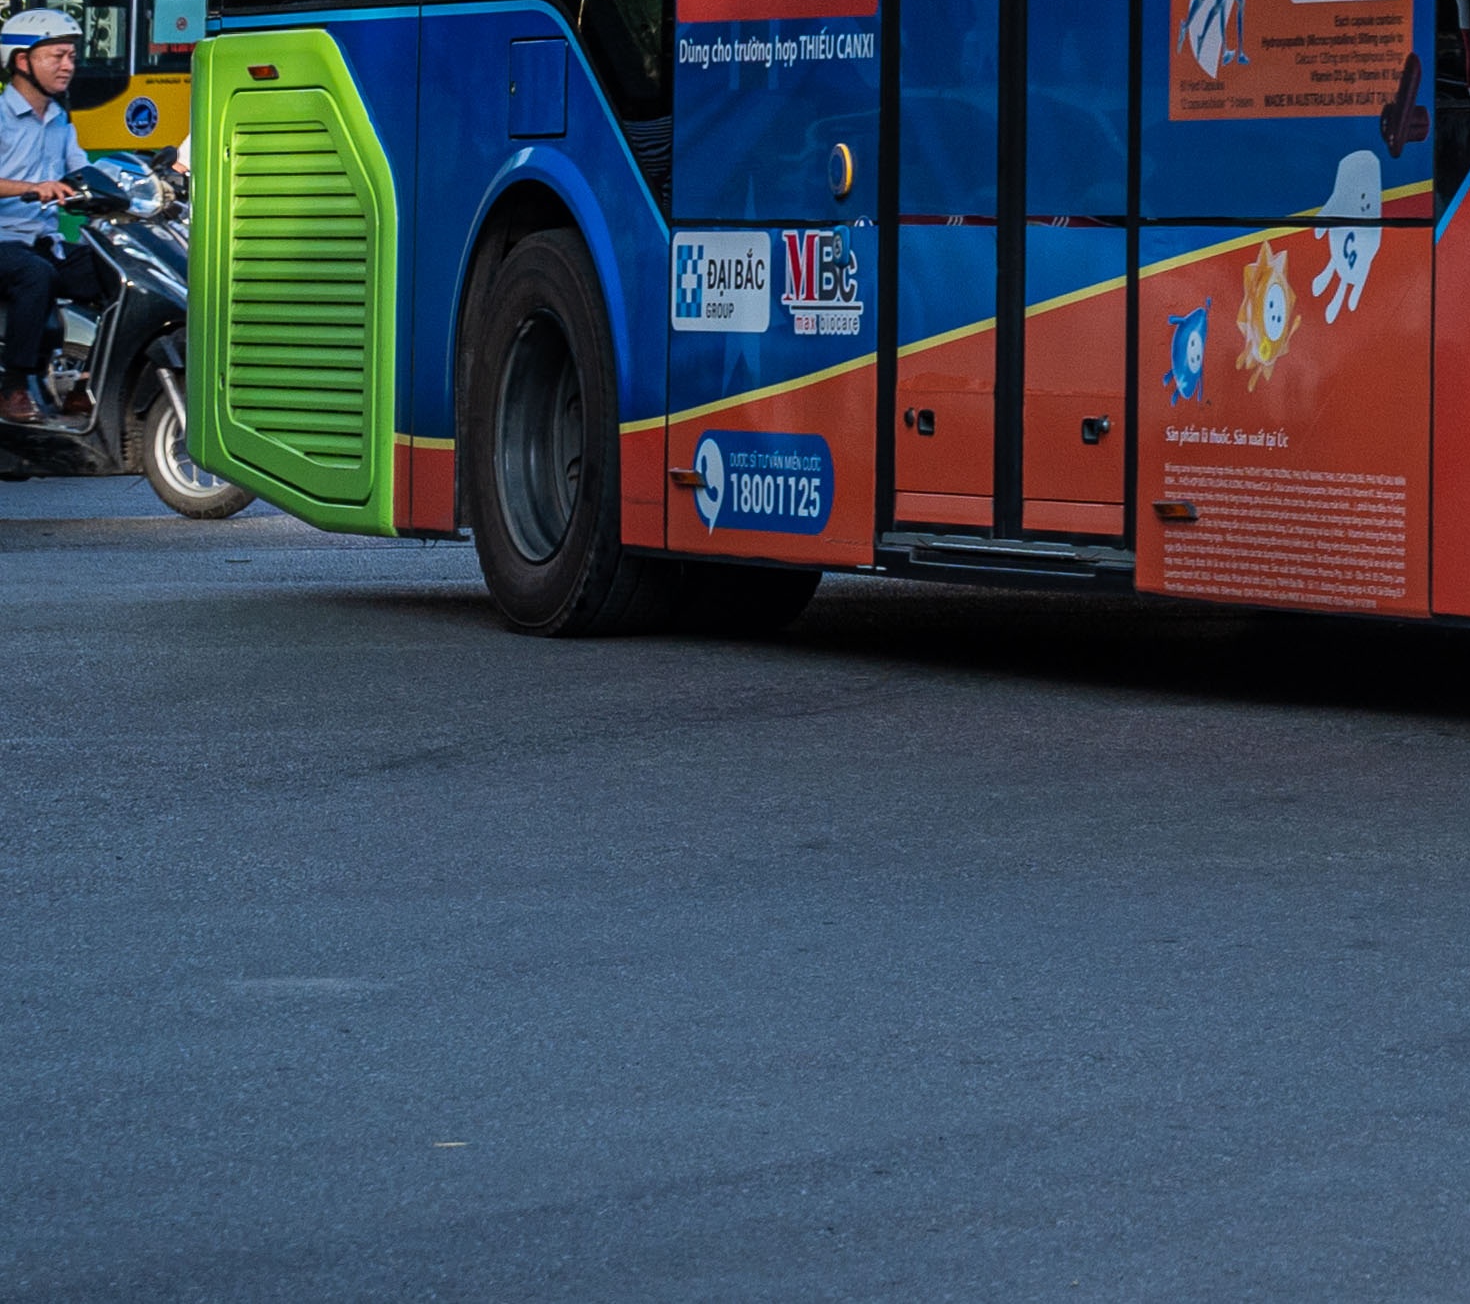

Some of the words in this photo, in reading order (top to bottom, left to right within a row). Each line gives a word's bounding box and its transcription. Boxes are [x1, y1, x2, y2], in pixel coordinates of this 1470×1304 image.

[678, 39, 710, 70] Dùng
[711, 37, 733, 63] cho
[733, 35, 773, 69] trường
[774, 34, 798, 69] hợp
[799, 26, 835, 61] THIẾU
[836, 32, 875, 60] CANXI
[707, 258, 733, 297] ĐẠI
[734, 248, 766, 290] BẮC
[705, 302, 735, 319] GROUP
[795, 315, 817, 333] max
[730, 473, 821, 518] 18001125
